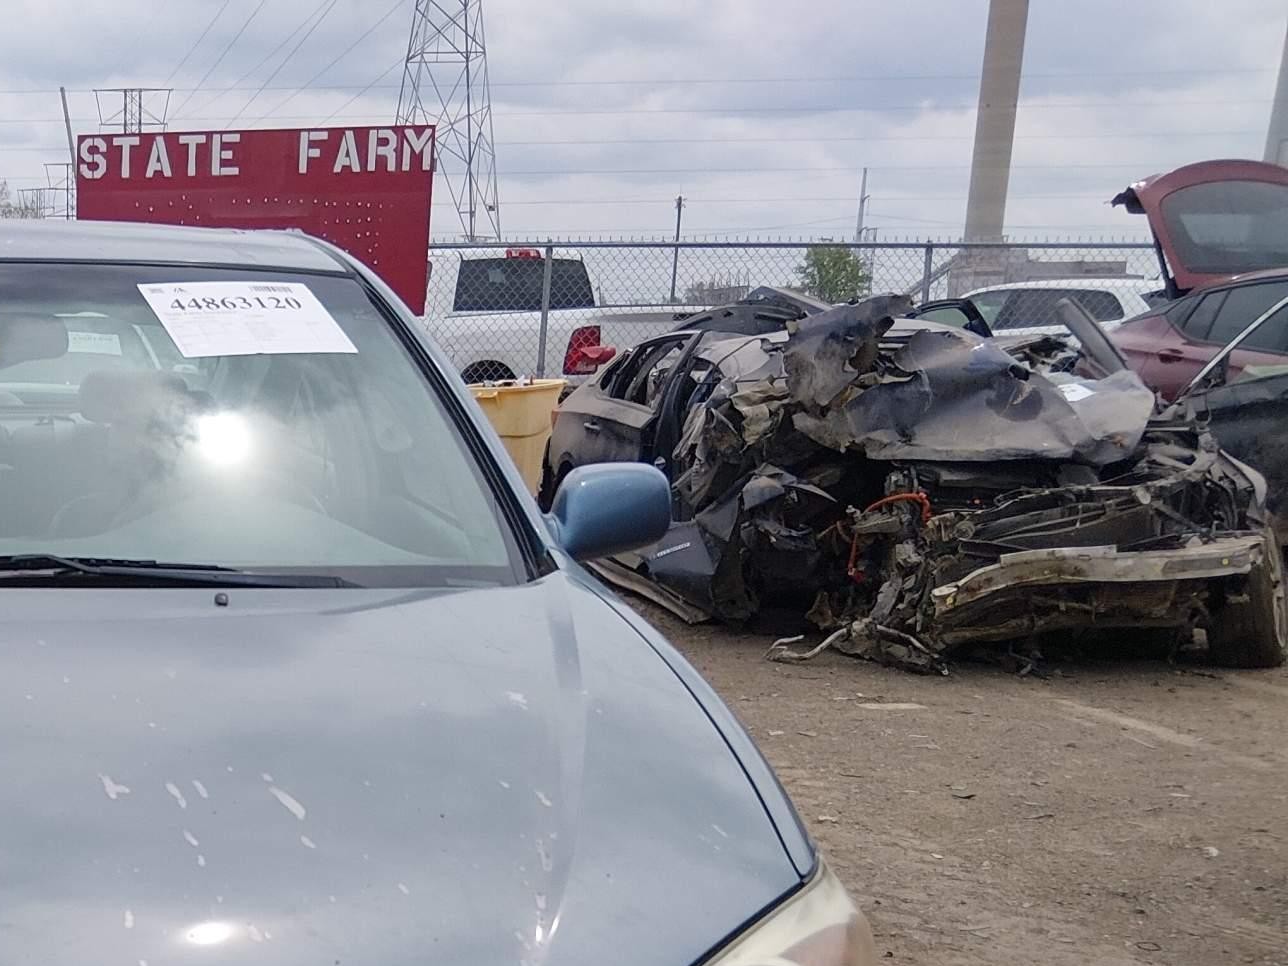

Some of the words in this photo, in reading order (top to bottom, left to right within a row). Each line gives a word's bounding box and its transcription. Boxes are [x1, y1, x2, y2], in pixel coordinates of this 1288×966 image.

[79, 133, 241, 179] STATE
[298, 128, 433, 174] FARM
[170, 296, 302, 311] 44863120
